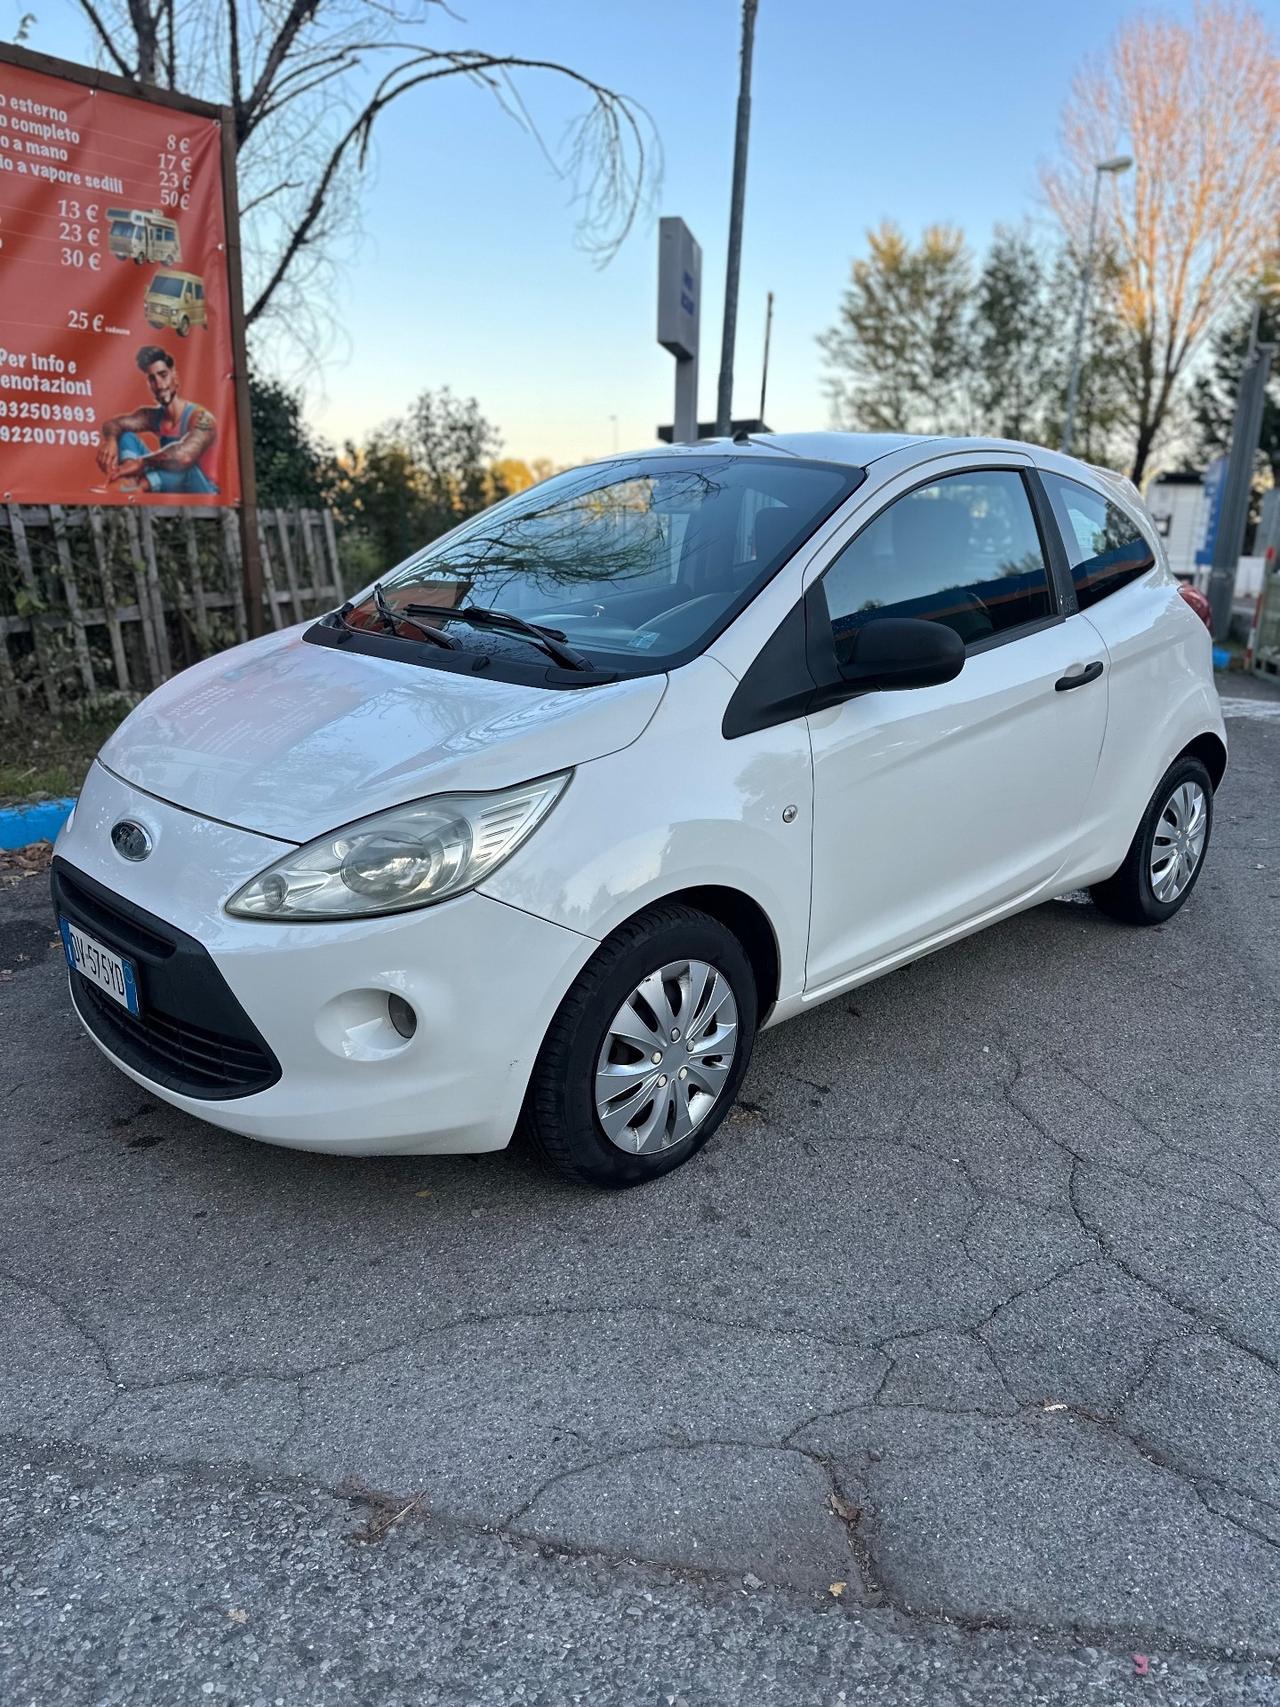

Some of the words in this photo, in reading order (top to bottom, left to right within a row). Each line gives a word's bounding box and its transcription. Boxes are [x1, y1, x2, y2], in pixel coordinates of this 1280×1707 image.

[10, 97, 68, 123] esterno
[11, 117, 80, 144] completo
[13, 139, 23, 151] a
[25, 141, 68, 161] mano
[167, 134, 176, 151] 8
[179, 138, 191, 154] €
[158, 153, 177, 171] 17
[180, 156, 192, 173] €
[17, 161, 27, 174] a
[30, 163, 81, 183] vapore
[85, 176, 123, 194] sedili
[159, 172, 179, 189] 23
[182, 175, 192, 192] €
[57, 199, 81, 219] 13
[86, 204, 99, 223] €
[160, 189, 179, 207] 50
[180, 193, 191, 210] €
[59, 222, 82, 242] 23
[87, 228, 101, 247] €
[60, 247, 84, 268] 30
[88, 252, 102, 271] €
[67, 309, 89, 330] 25
[92, 313, 104, 333] €
[0, 348, 27, 368] Per
[31, 353, 65, 373] info
[67, 360, 77, 375] e
[0, 375, 92, 395] enotazioni
[0, 426, 100, 446] 922007095
